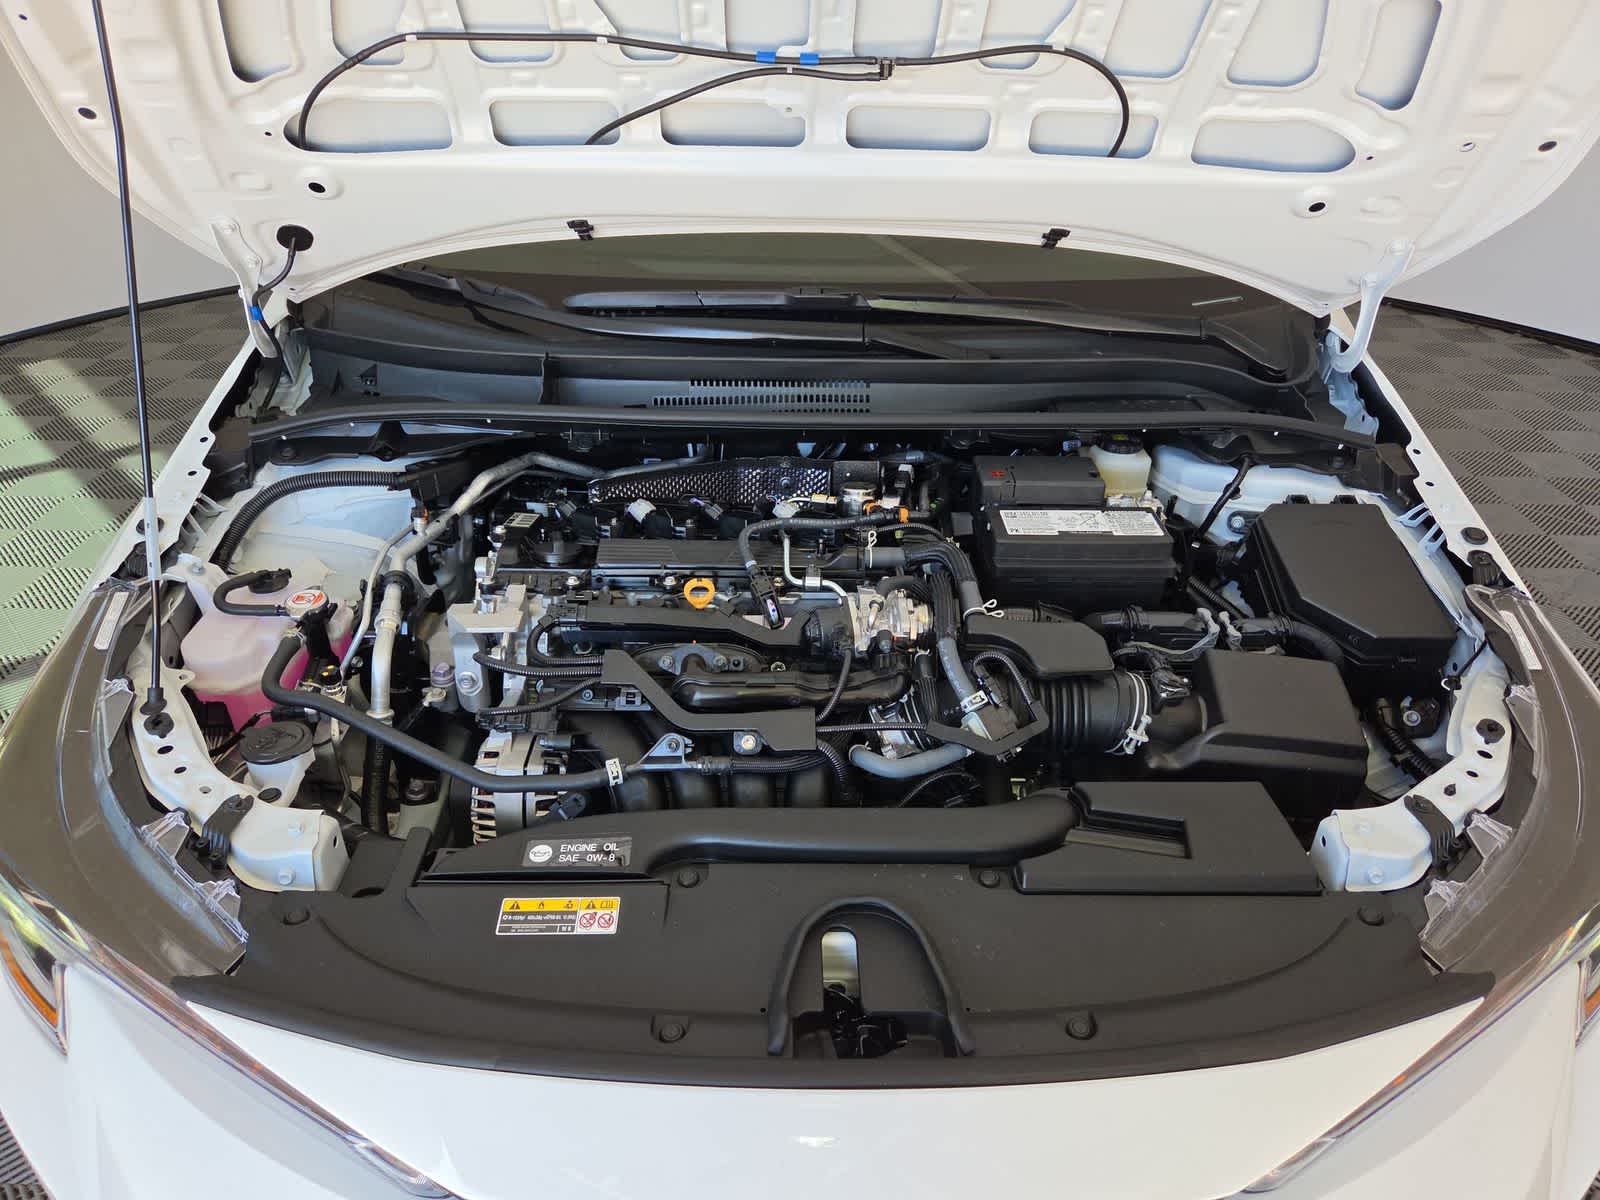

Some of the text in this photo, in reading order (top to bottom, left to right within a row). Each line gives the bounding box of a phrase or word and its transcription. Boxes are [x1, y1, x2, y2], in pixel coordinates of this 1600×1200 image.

[560, 842, 620, 852] ENGINE OIL
[558, 853, 615, 862] SAE 0W-8
